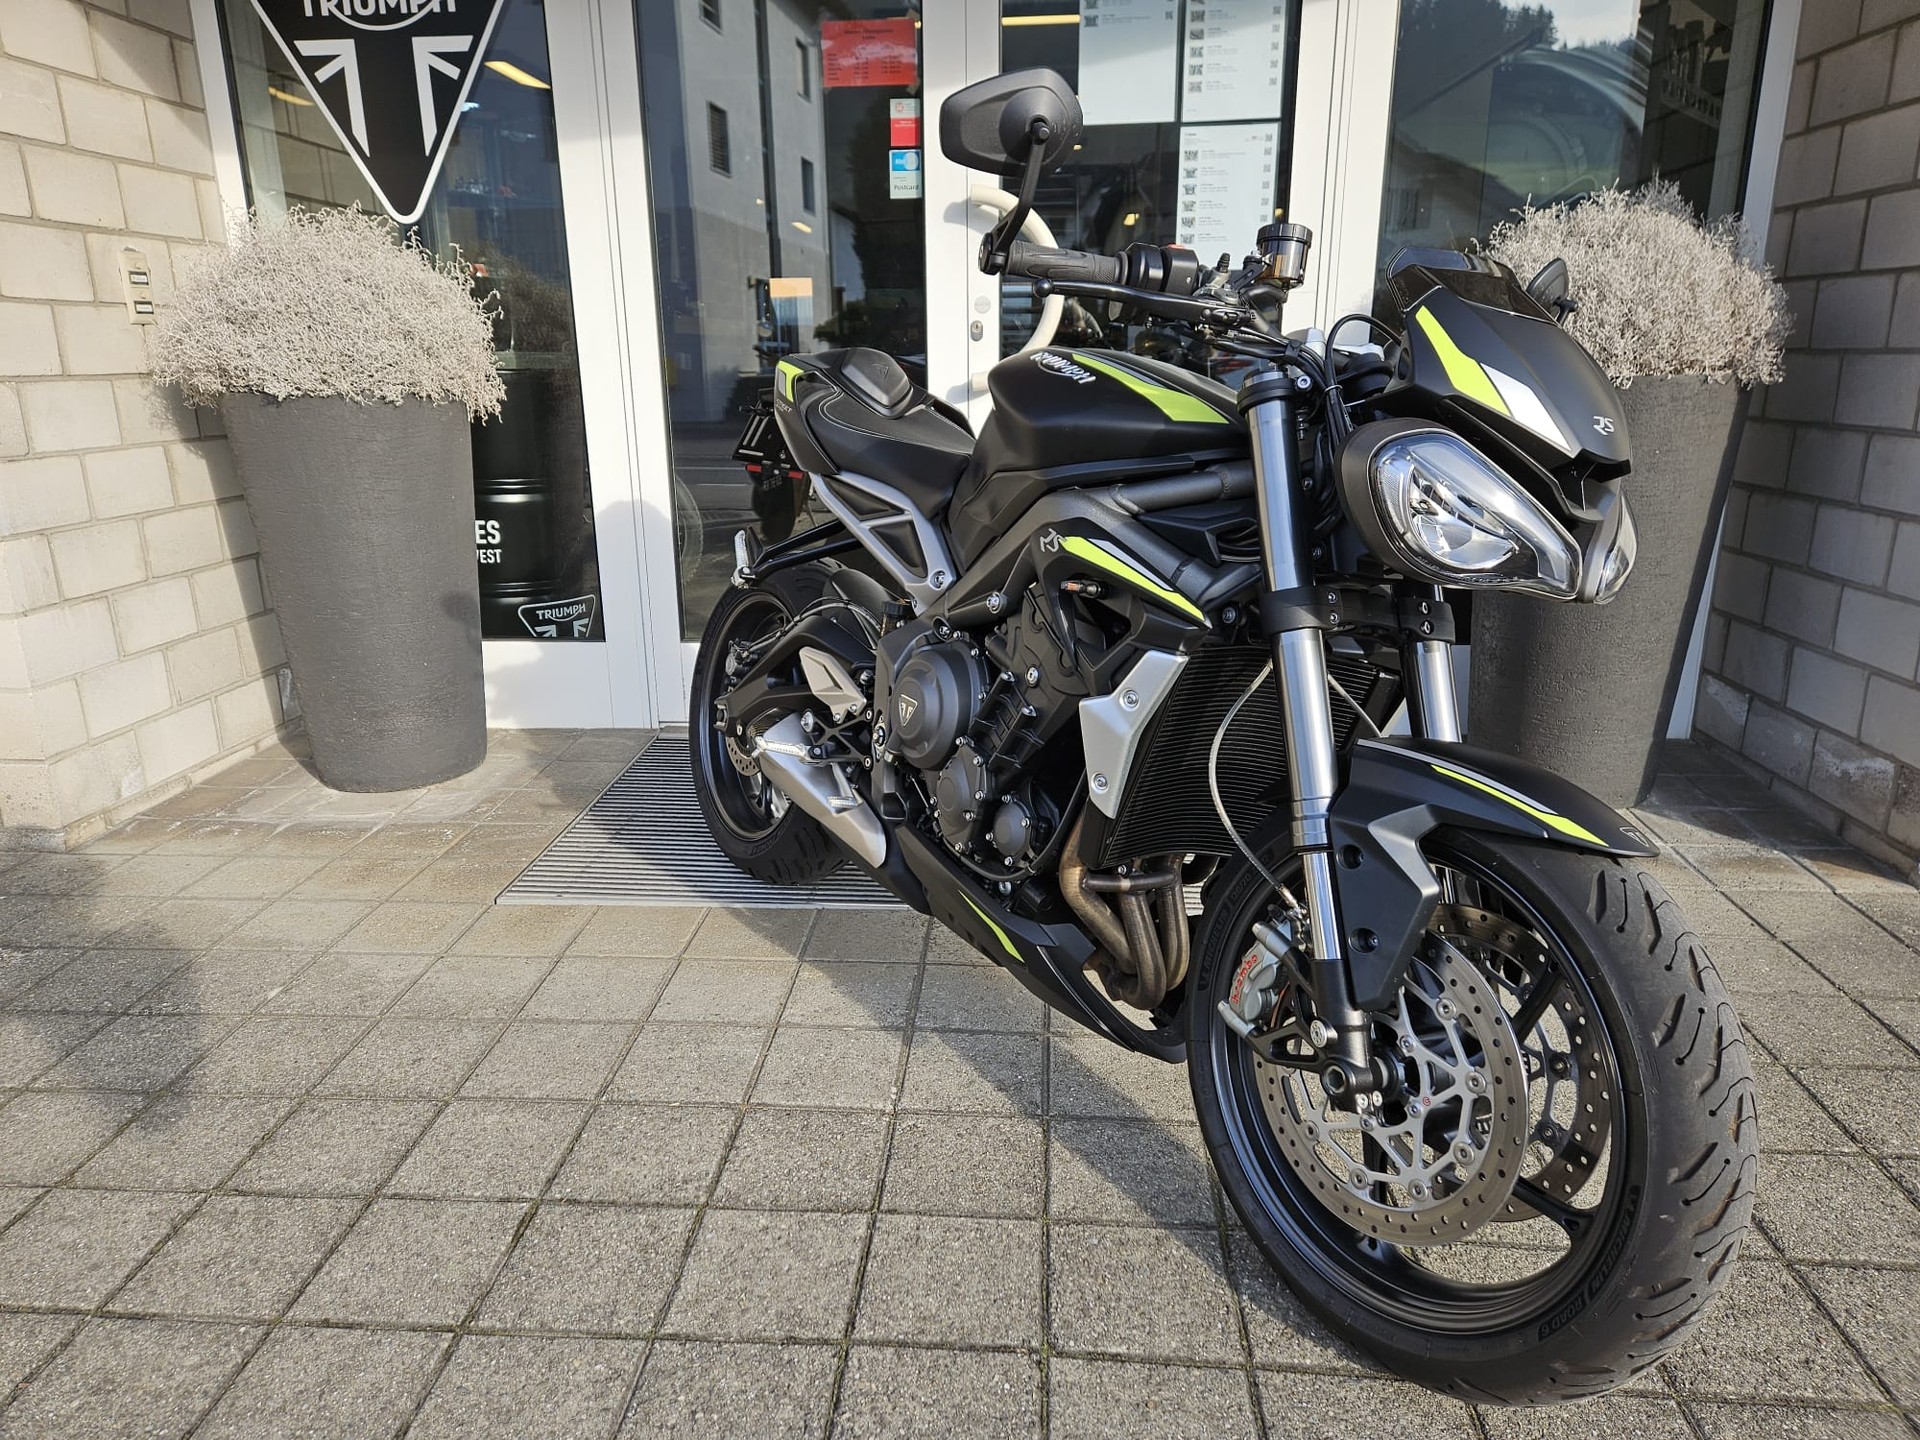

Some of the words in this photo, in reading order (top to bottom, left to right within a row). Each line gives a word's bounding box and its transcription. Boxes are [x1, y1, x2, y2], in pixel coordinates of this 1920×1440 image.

[1030, 352, 1096, 384] TRIUMPH
[1593, 416, 1614, 435] RS
[1040, 528, 1067, 552] RS
[476, 549, 502, 563] EST
[536, 603, 586, 620] TRIUMPH
[1231, 954, 1258, 1004] brembo
[1589, 1216, 1631, 1294] MICHELIN
[1552, 1294, 1585, 1330] ROAD
